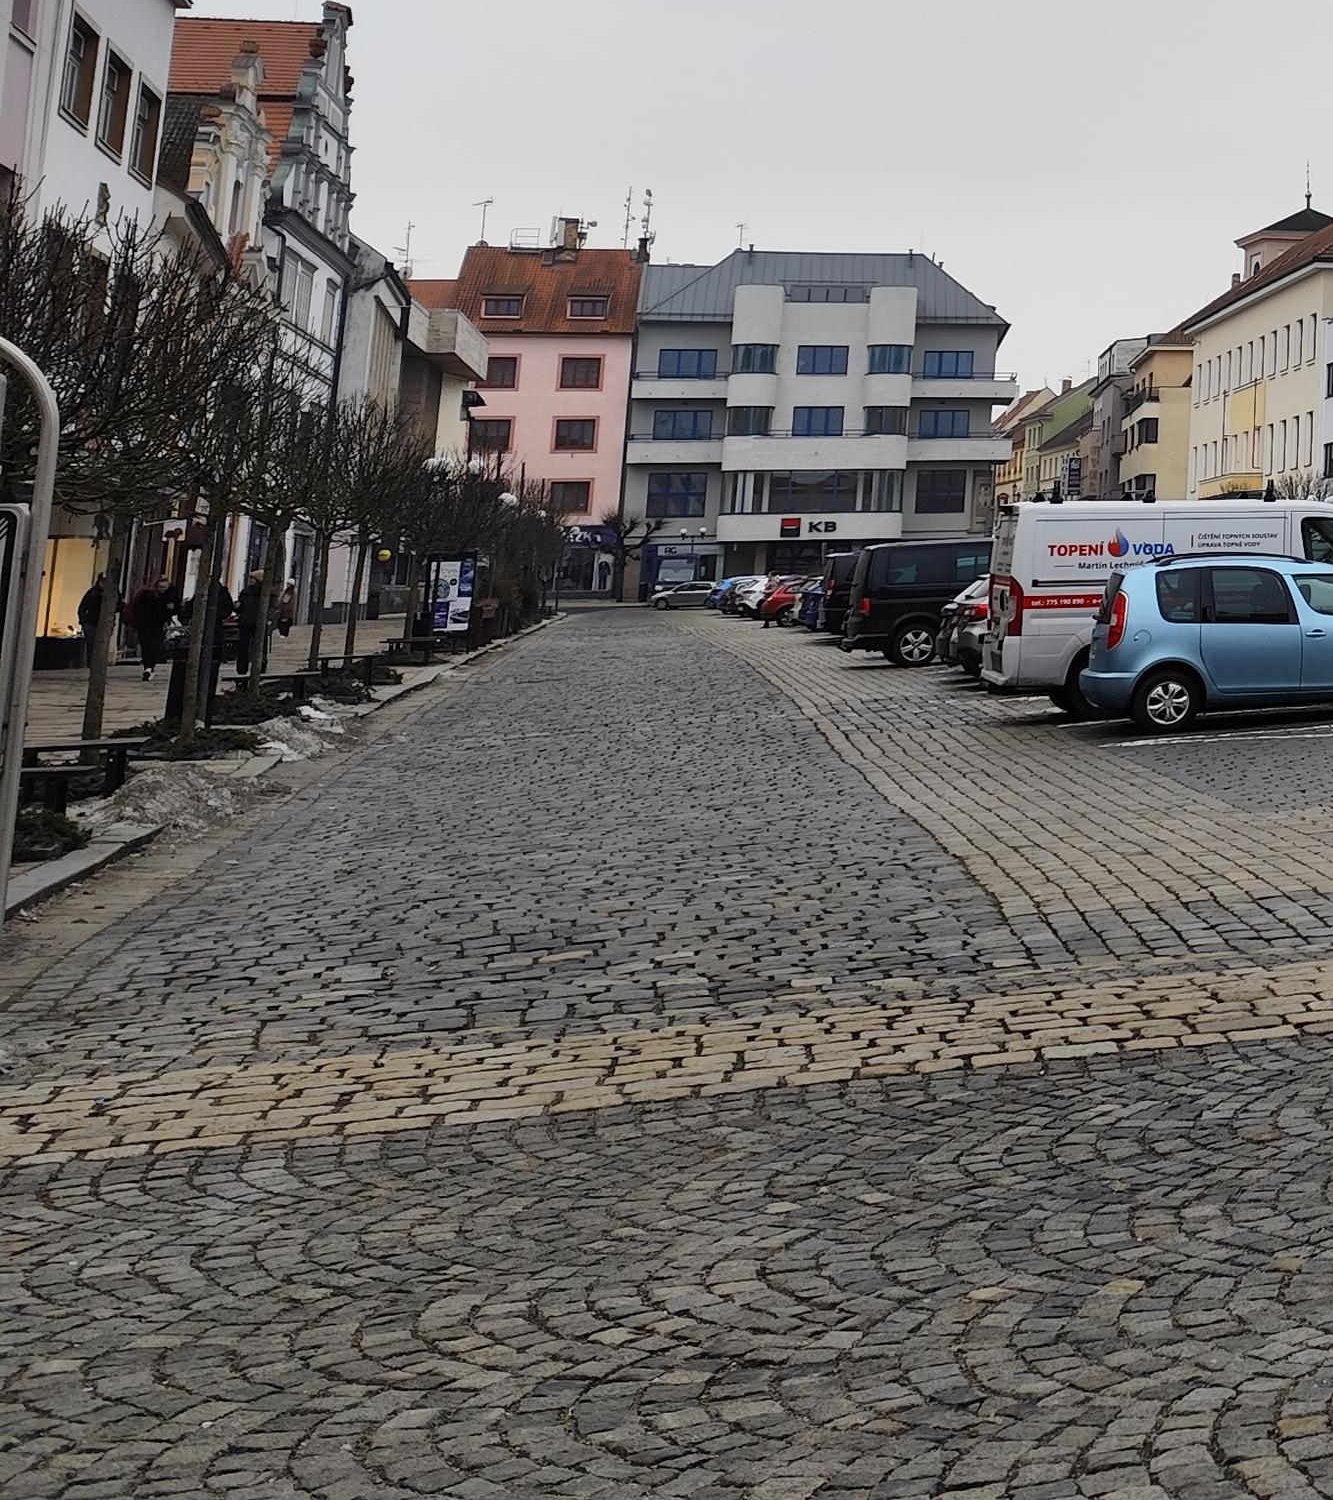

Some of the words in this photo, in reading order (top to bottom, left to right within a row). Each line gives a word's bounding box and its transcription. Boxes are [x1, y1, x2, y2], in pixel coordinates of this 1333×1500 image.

[808, 521, 837, 533] KB
[1047, 541, 1105, 557] TOPENÍ
[1132, 542, 1175, 556] VODA
[1078, 561, 1108, 570] Martin
